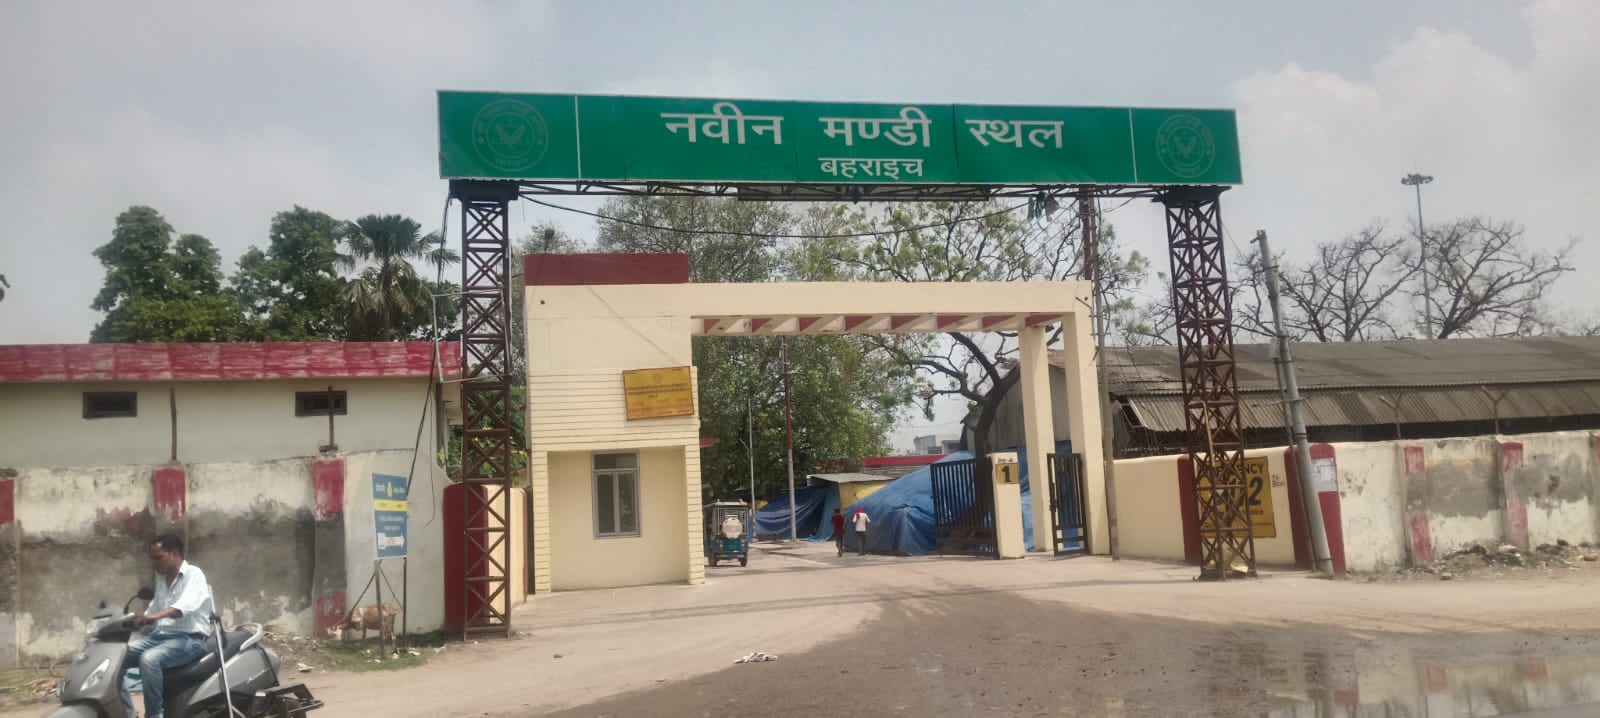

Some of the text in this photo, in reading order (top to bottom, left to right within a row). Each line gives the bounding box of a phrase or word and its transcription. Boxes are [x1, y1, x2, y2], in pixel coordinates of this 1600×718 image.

[660, 101, 1065, 149] नवीन मण्डी स्थल
[818, 157, 924, 181] बहराइच
[1001, 465, 1012, 483] 1
